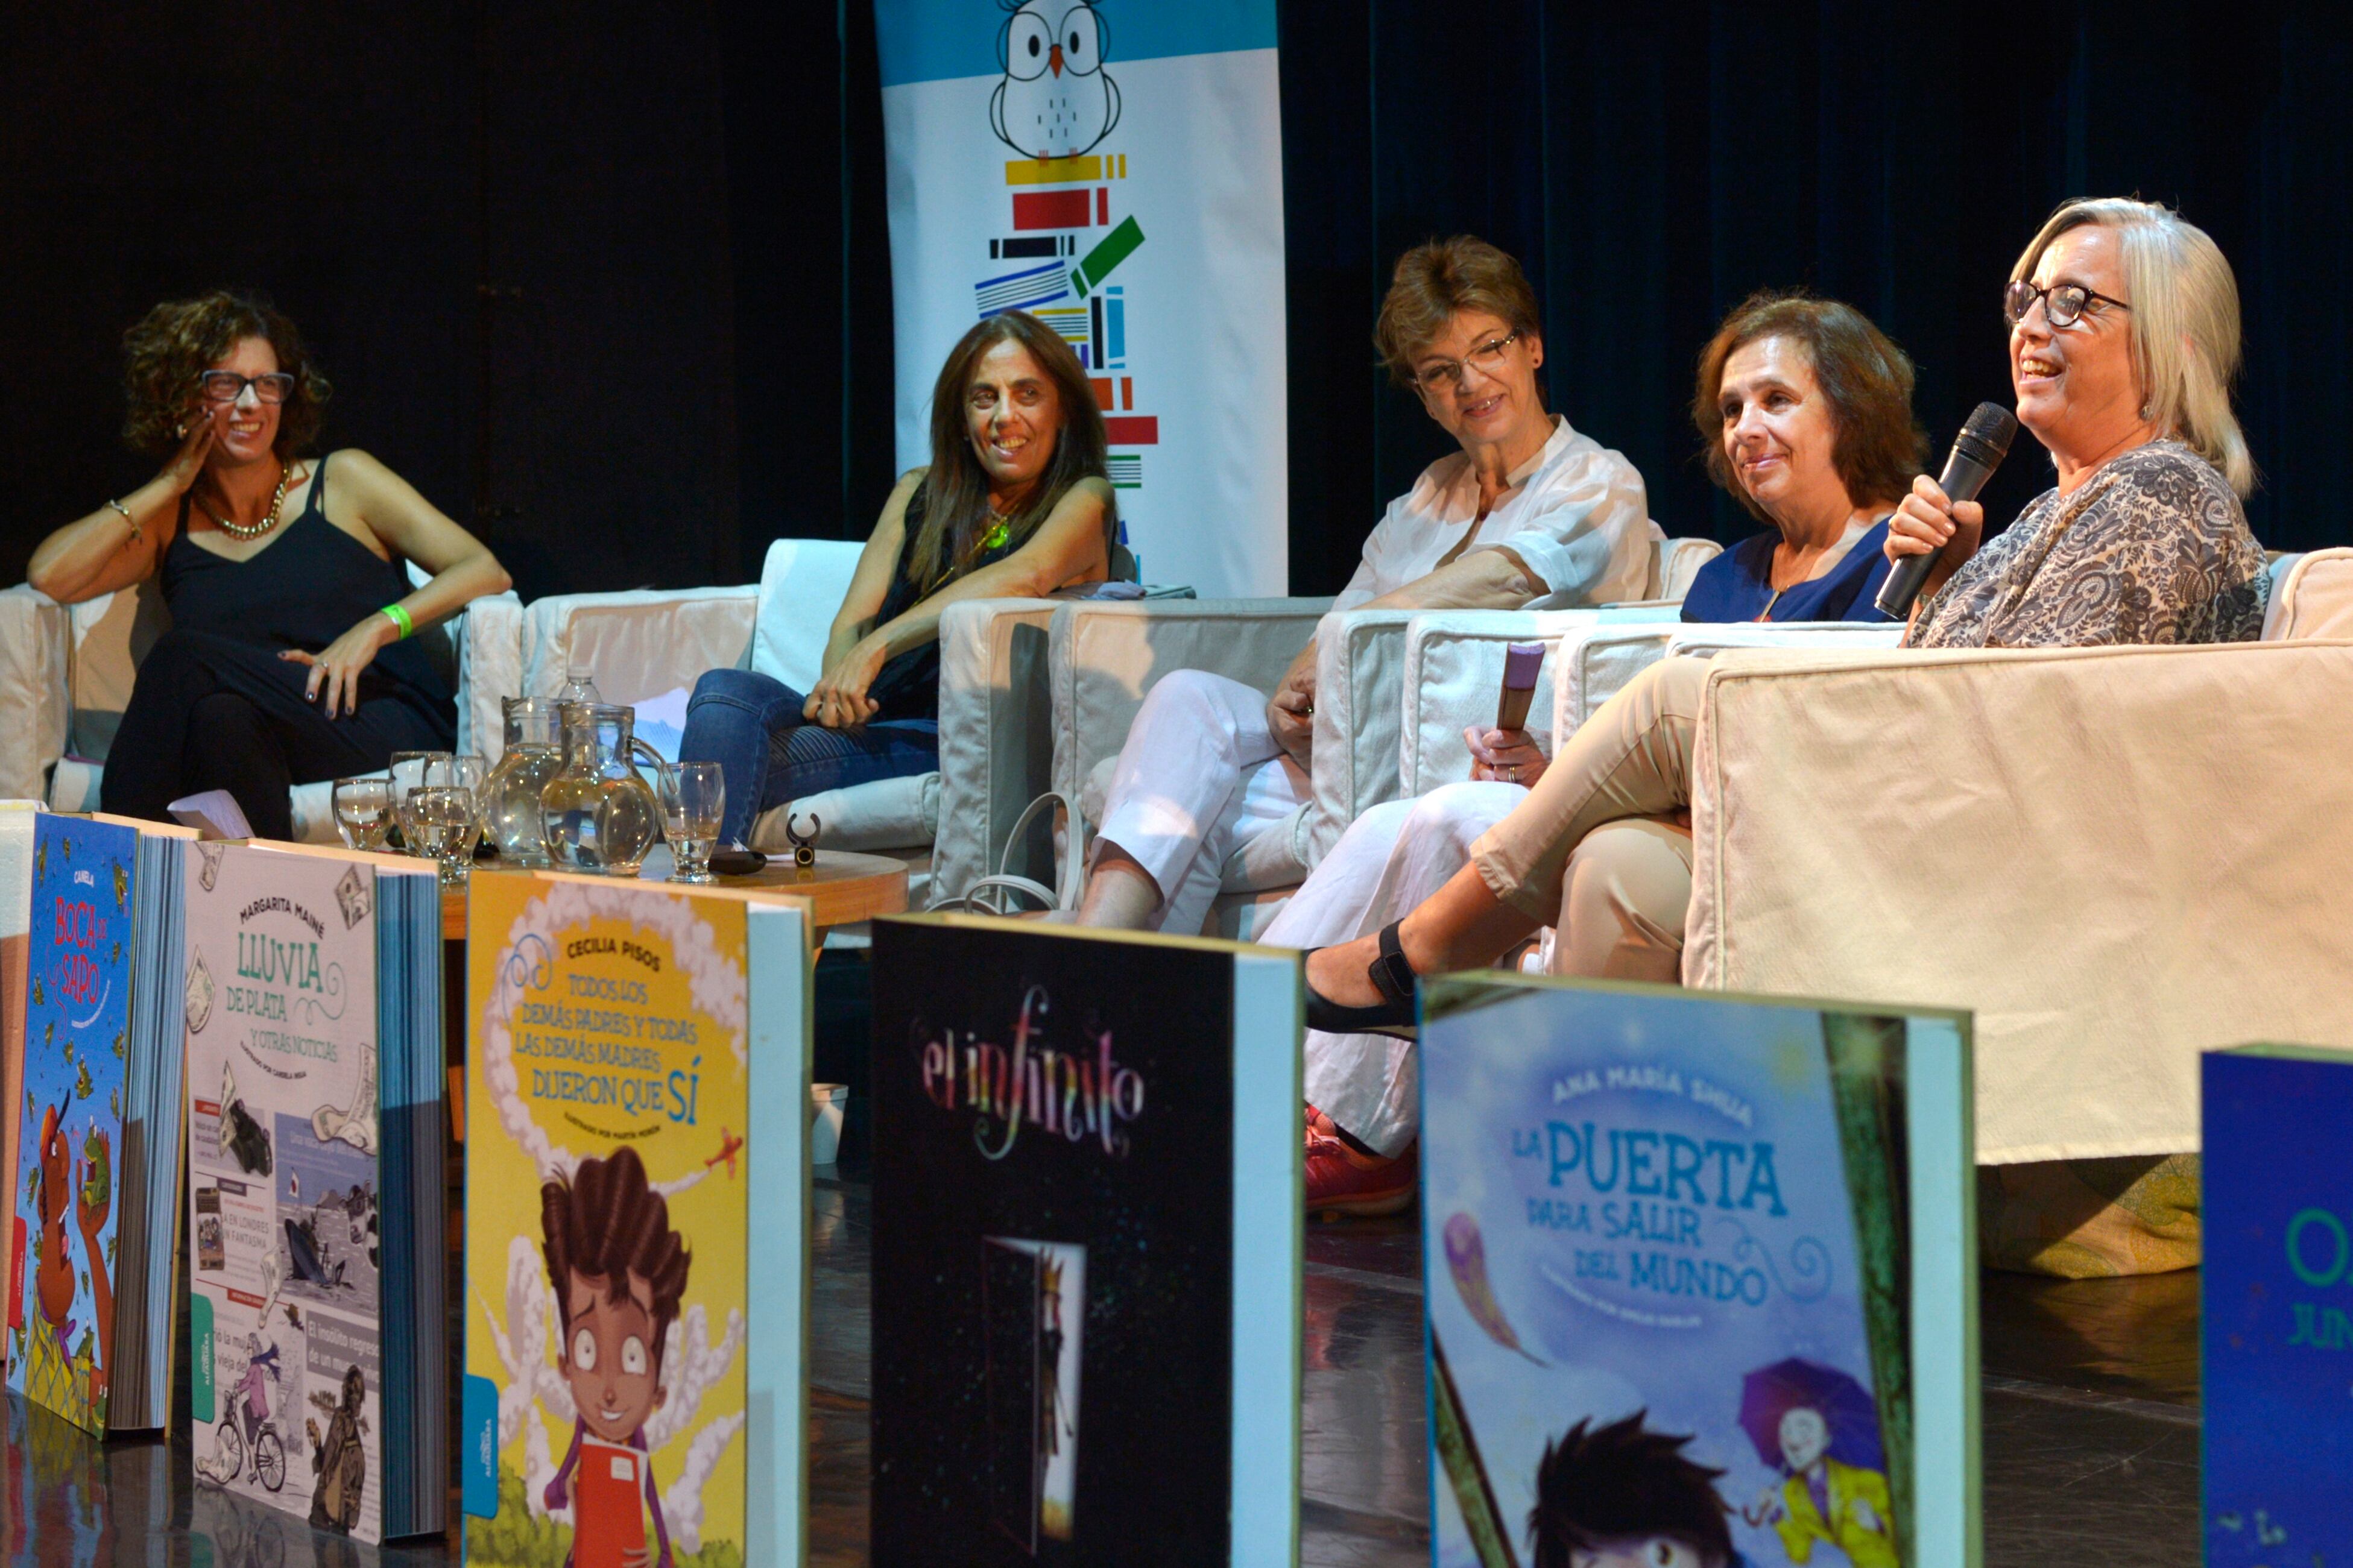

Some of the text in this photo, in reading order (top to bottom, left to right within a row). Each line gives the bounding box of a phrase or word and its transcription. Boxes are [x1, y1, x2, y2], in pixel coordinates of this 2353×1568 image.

[55, 896, 107, 950] BOCA DE
[240, 897, 324, 940] MARGARITA MAINÉ
[238, 932, 323, 993] LLUVIA
[567, 938, 661, 972] CECILIA PISOS
[62, 952, 99, 1004] SAPO
[569, 974, 649, 1006] TODOS LOS
[226, 986, 288, 1022] DE PLATA
[522, 1000, 699, 1045] DEMÁS PADRES Y TODAS
[250, 1027, 338, 1063] Y OTRAS NOTICIAS
[515, 1031, 662, 1074] LAS DEMÁS MADRES
[621, 1078, 664, 1117] QUE
[667, 1055, 702, 1126] SÍ
[1553, 1069, 1602, 1105] ANA
[1512, 1120, 1789, 1218] LA PUERTA
[232, 1230, 267, 1249] FANTASMA
[1526, 1197, 1704, 1248] PARA SALIR
[2285, 1207, 2353, 1288] O
[1574, 1248, 1620, 1282] DEL
[1629, 1250, 1768, 1308] MUNDO
[223, 1330, 230, 1346] la
[308, 1320, 317, 1338] El
[318, 1323, 348, 1347] insólito
[217, 1353, 235, 1373] vieja
[308, 1346, 319, 1365] de
[320, 1353, 332, 1368] un
